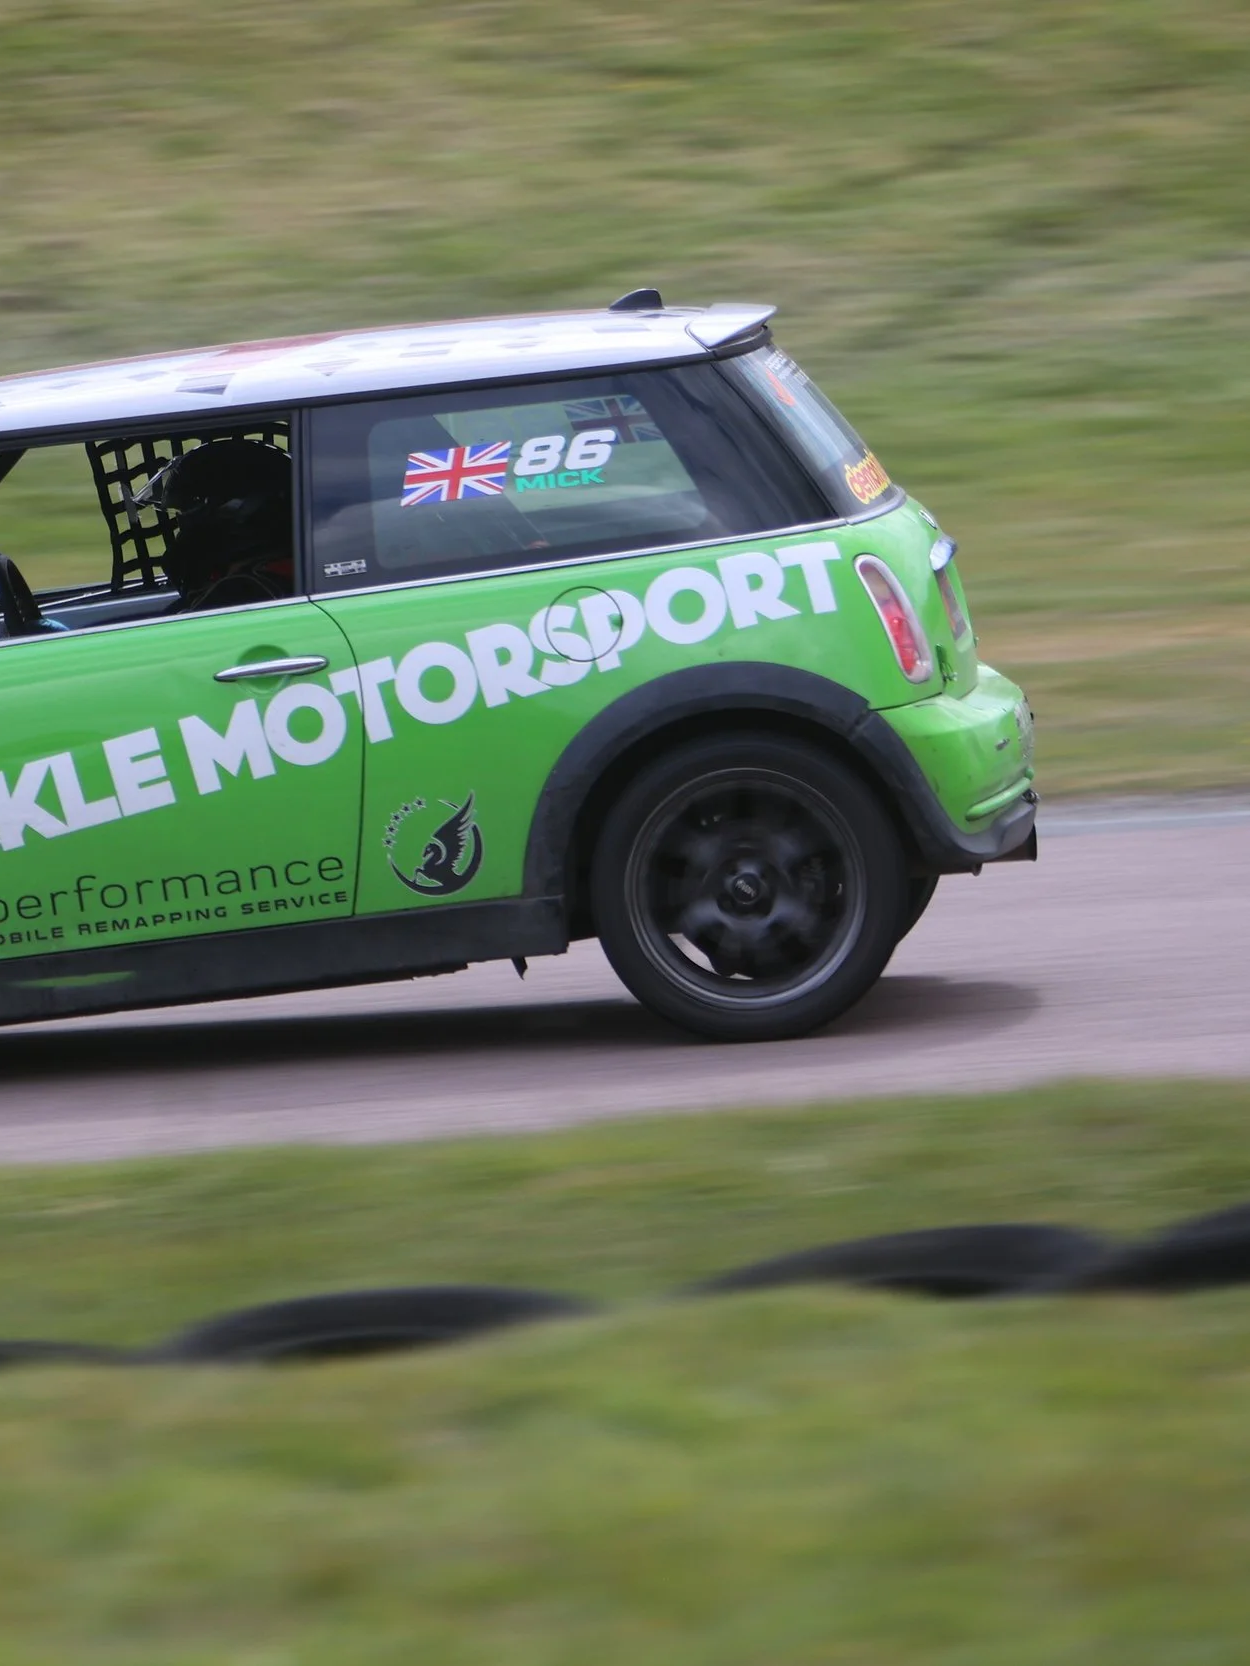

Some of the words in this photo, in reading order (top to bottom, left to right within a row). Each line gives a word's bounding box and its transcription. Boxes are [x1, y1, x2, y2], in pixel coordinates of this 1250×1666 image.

[513, 429, 616, 476] 86
[514, 468, 605, 493] MICK
[178, 541, 841, 795] MOTORSPORT
[78, 906, 227, 936] REMAPPING
[241, 891, 348, 915] SERVICE
